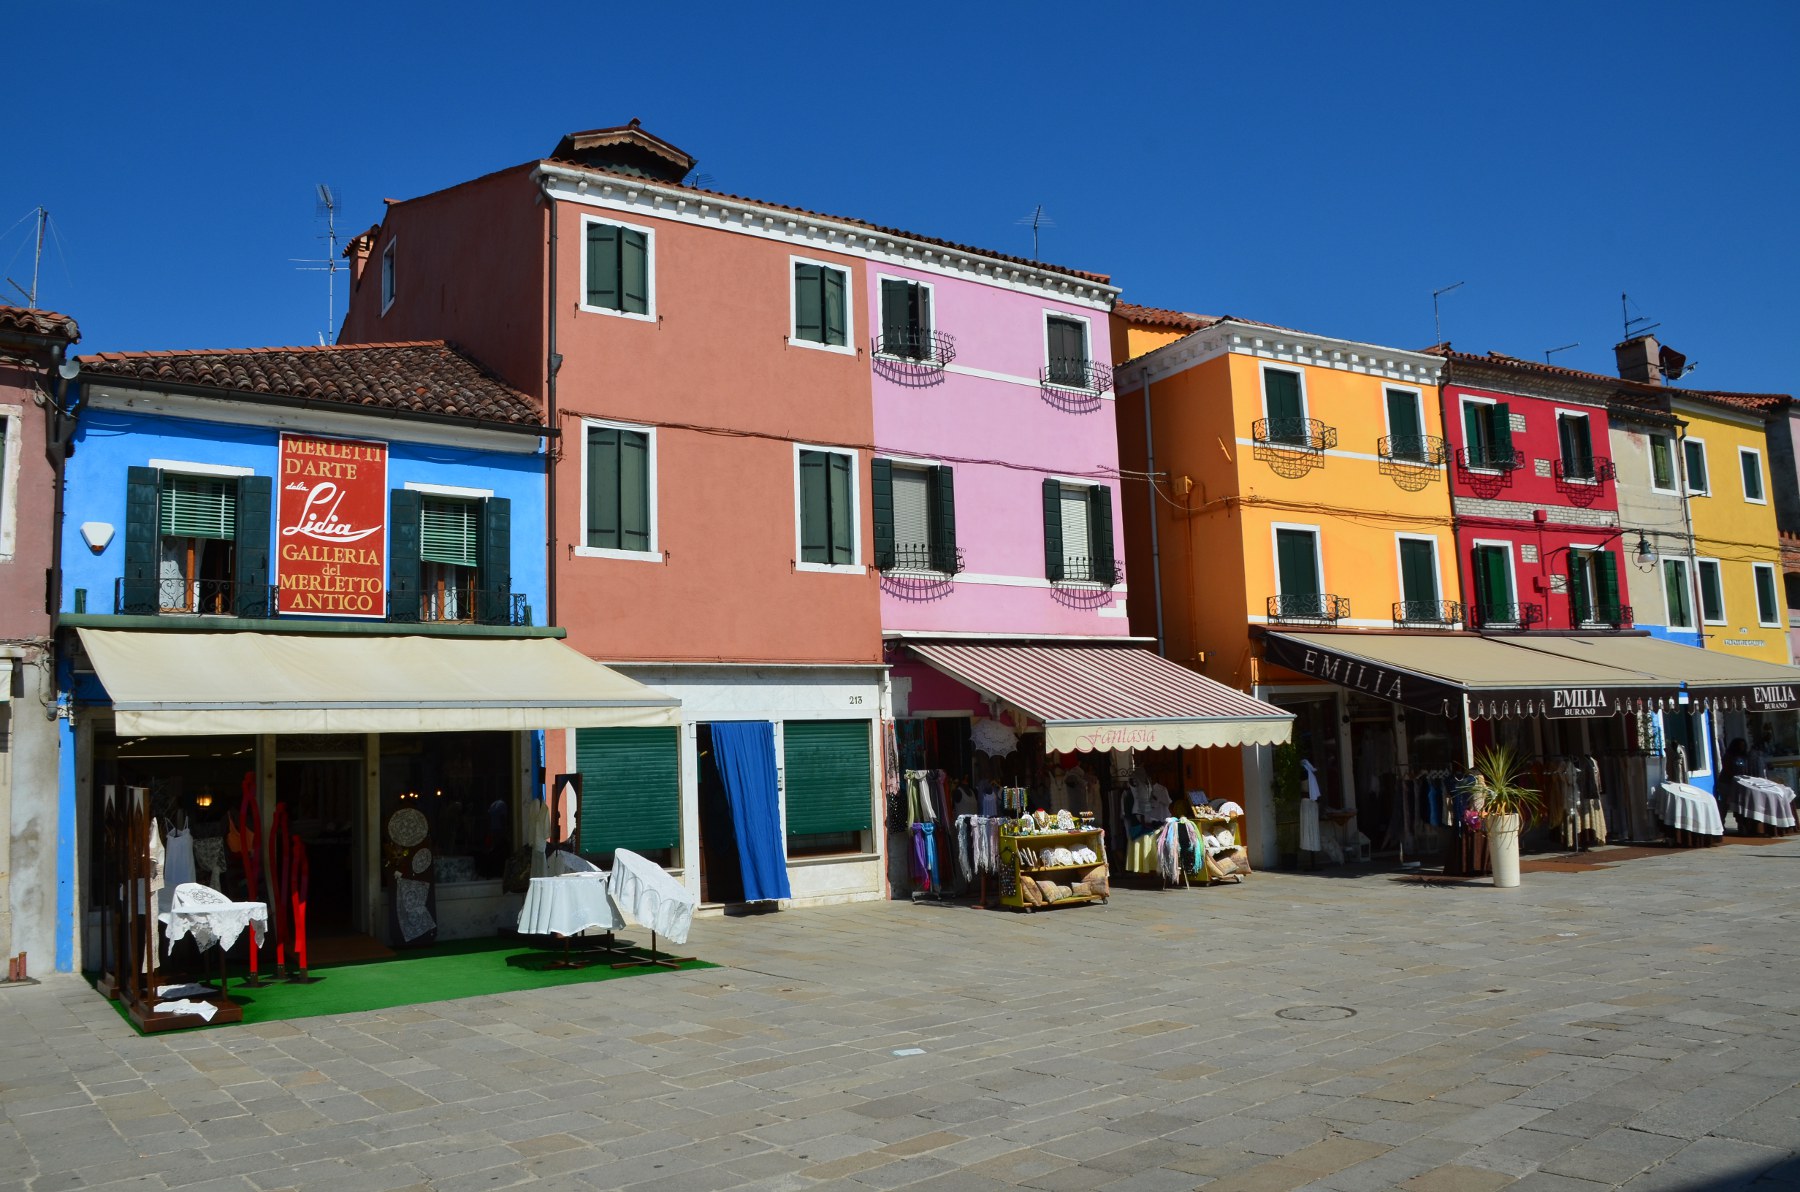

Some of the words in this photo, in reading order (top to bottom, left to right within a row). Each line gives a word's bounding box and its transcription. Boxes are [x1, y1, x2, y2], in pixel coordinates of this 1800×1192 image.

[286, 438, 382, 462] MERLETTI
[285, 458, 357, 480] D'ARTE
[282, 481, 383, 543] Lidia
[282, 544, 380, 566] GALLERIA
[322, 563, 341, 576] del
[280, 574, 382, 594] MERLETTO
[290, 593, 373, 611] ANTICO
[1302, 649, 1402, 699] EMILIA
[849, 696, 863, 705] 213
[1553, 689, 1607, 708] EMILIA
[1753, 686, 1797, 703] EMILIA
[1564, 708, 1596, 716] BURANO
[1764, 702, 1788, 710] BURANO
